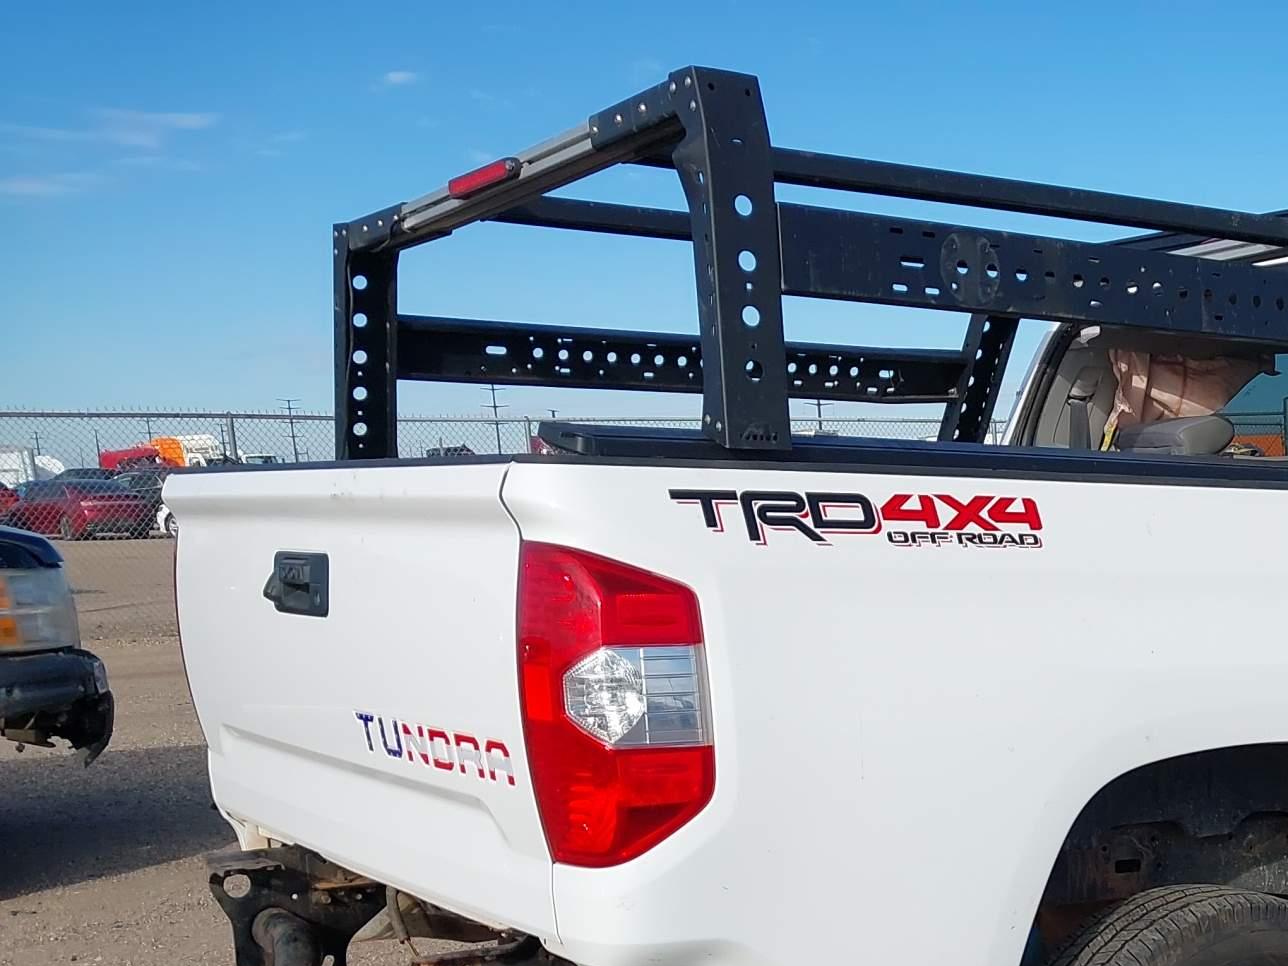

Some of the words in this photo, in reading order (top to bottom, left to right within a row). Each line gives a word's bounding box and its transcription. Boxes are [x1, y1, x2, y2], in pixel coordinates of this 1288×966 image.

[668, 488, 881, 546] TRD
[886, 530, 952, 547] OFF
[956, 531, 1043, 549] ROAD
[353, 709, 517, 787] TUNDRA
